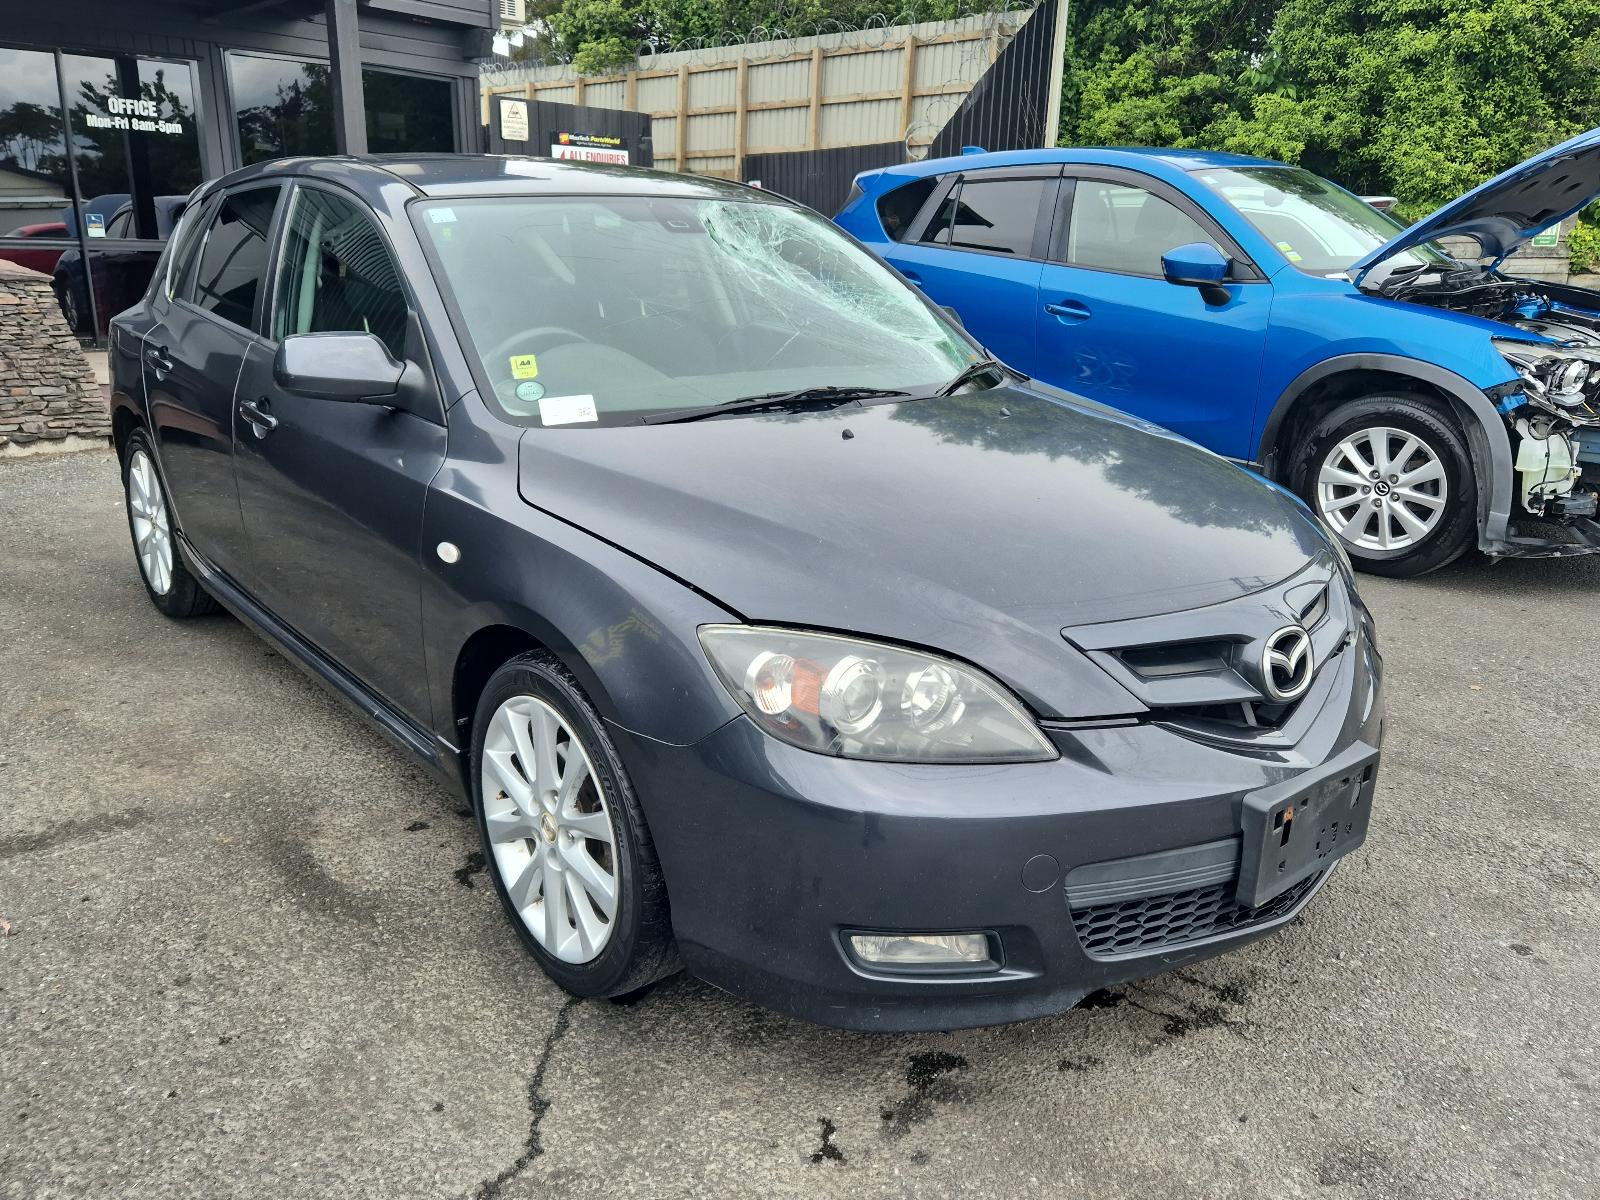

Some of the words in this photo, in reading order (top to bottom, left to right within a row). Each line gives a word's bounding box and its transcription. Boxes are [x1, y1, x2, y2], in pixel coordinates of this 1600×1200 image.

[108, 97, 158, 117] OFFICE
[86, 114, 130, 129] Mon-Fri
[131, 118, 183, 134] 8am-5pm
[586, 152, 626, 165] ENQUIRIES
